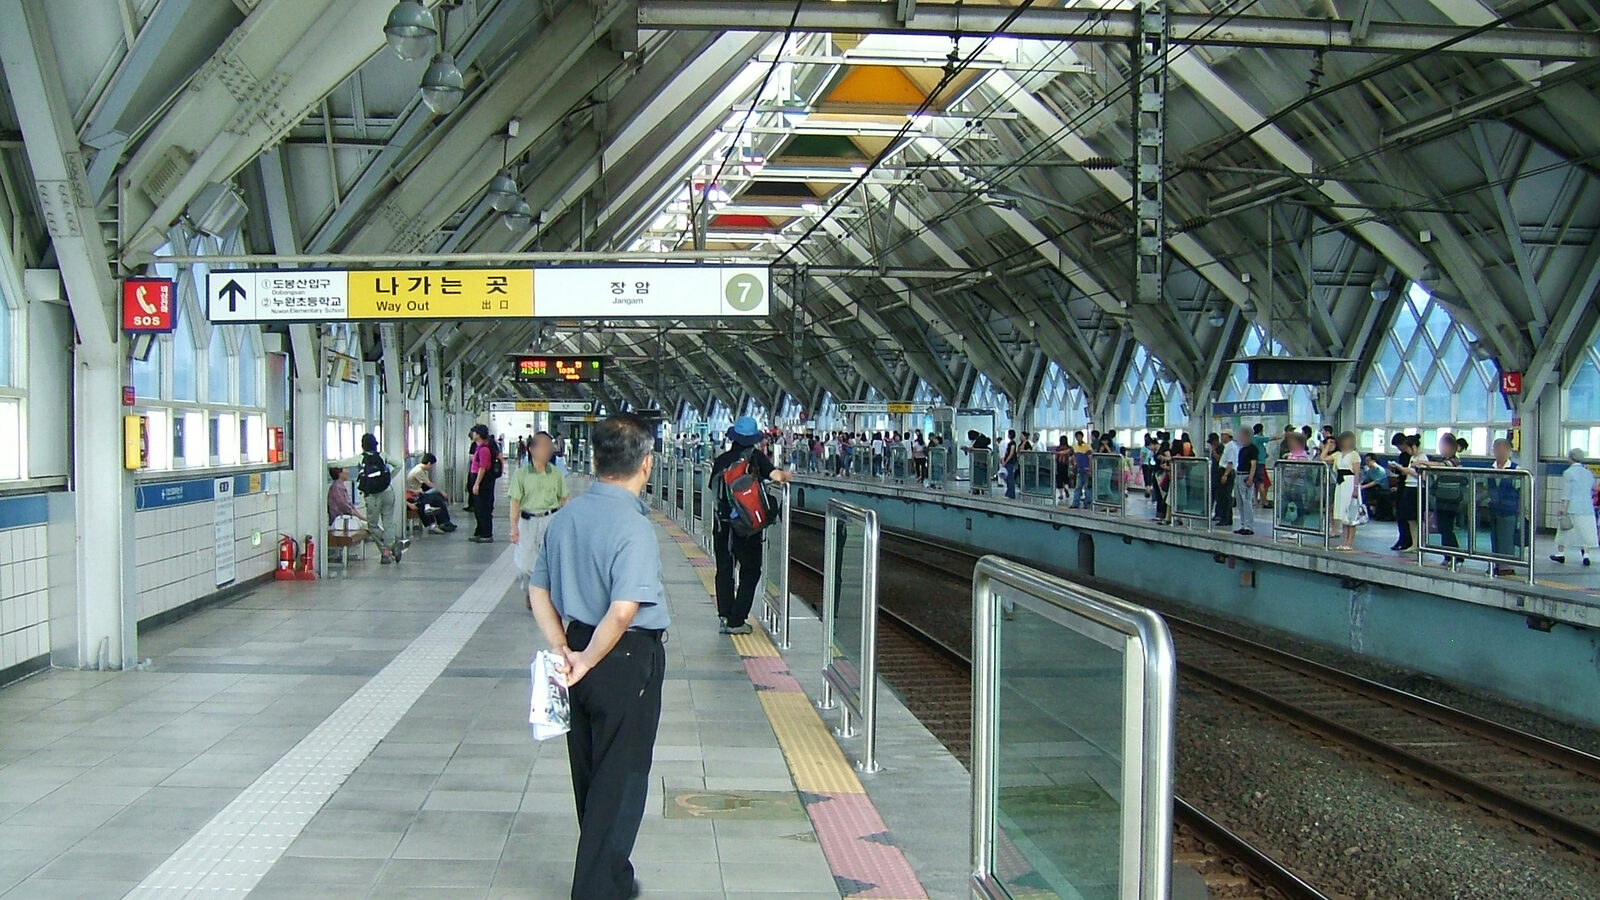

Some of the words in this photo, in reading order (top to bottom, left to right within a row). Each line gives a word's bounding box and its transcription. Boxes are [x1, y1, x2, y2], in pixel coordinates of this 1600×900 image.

[273, 279, 331, 289] 도봉산입구
[375, 276, 462, 295] 나가는
[486, 276, 508, 294] 곳
[610, 281, 650, 294] 장암
[737, 282, 752, 303] 7
[273, 296, 342, 307] 누원초등학교
[481, 300, 509, 310] 出口
[612, 297, 644, 305] Jangam
[289, 307, 323, 315] Elementary
[376, 301, 401, 312] Way
[406, 301, 430, 311] Out
[133, 316, 161, 326] SOS
